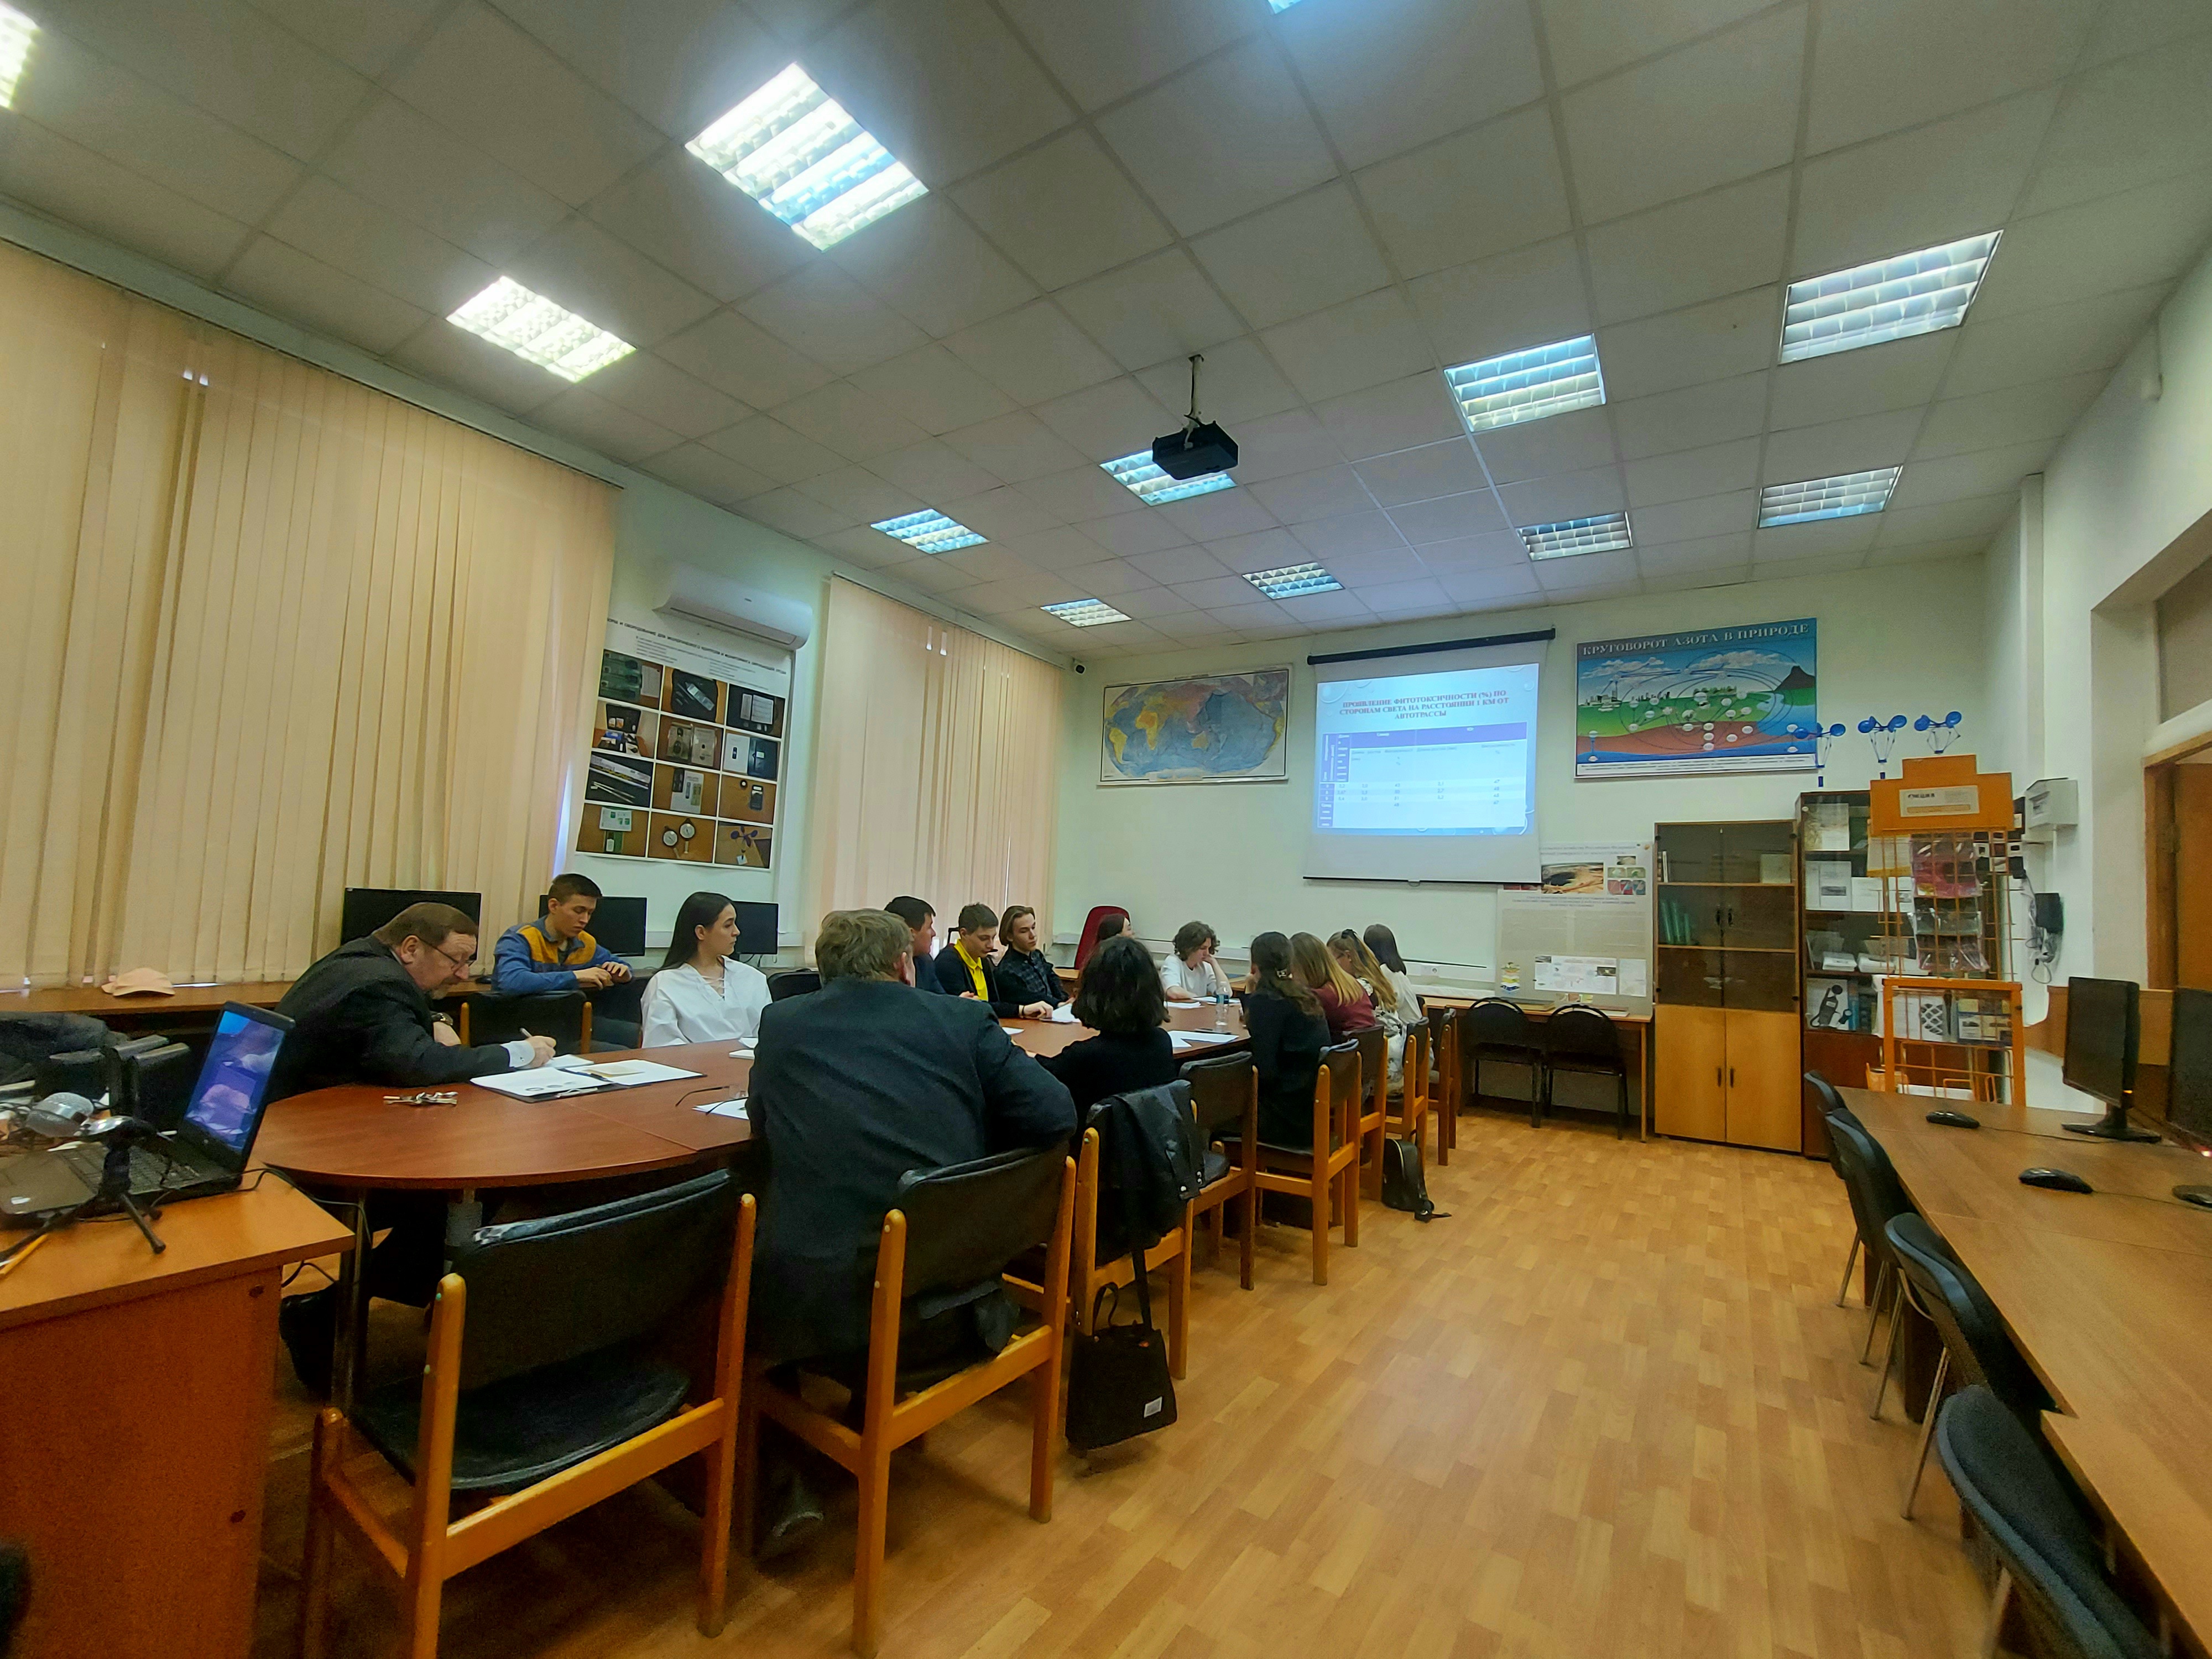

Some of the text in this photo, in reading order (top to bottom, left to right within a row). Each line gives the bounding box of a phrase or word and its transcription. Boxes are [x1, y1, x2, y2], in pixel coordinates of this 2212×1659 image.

[1583, 623, 1809, 655] КРУГОВОРОТ АЗОТА В ПРИРОДЕ
[1343, 699, 1392, 708] ПРОЯВЛЕНИЕ
[1394, 692, 1477, 705] ФИТОТОКСИЧНОСТИ
[1421, 700, 1474, 709] РАССТОЯНИИ
[1395, 711, 1447, 719] АВТОТРАССЫ
